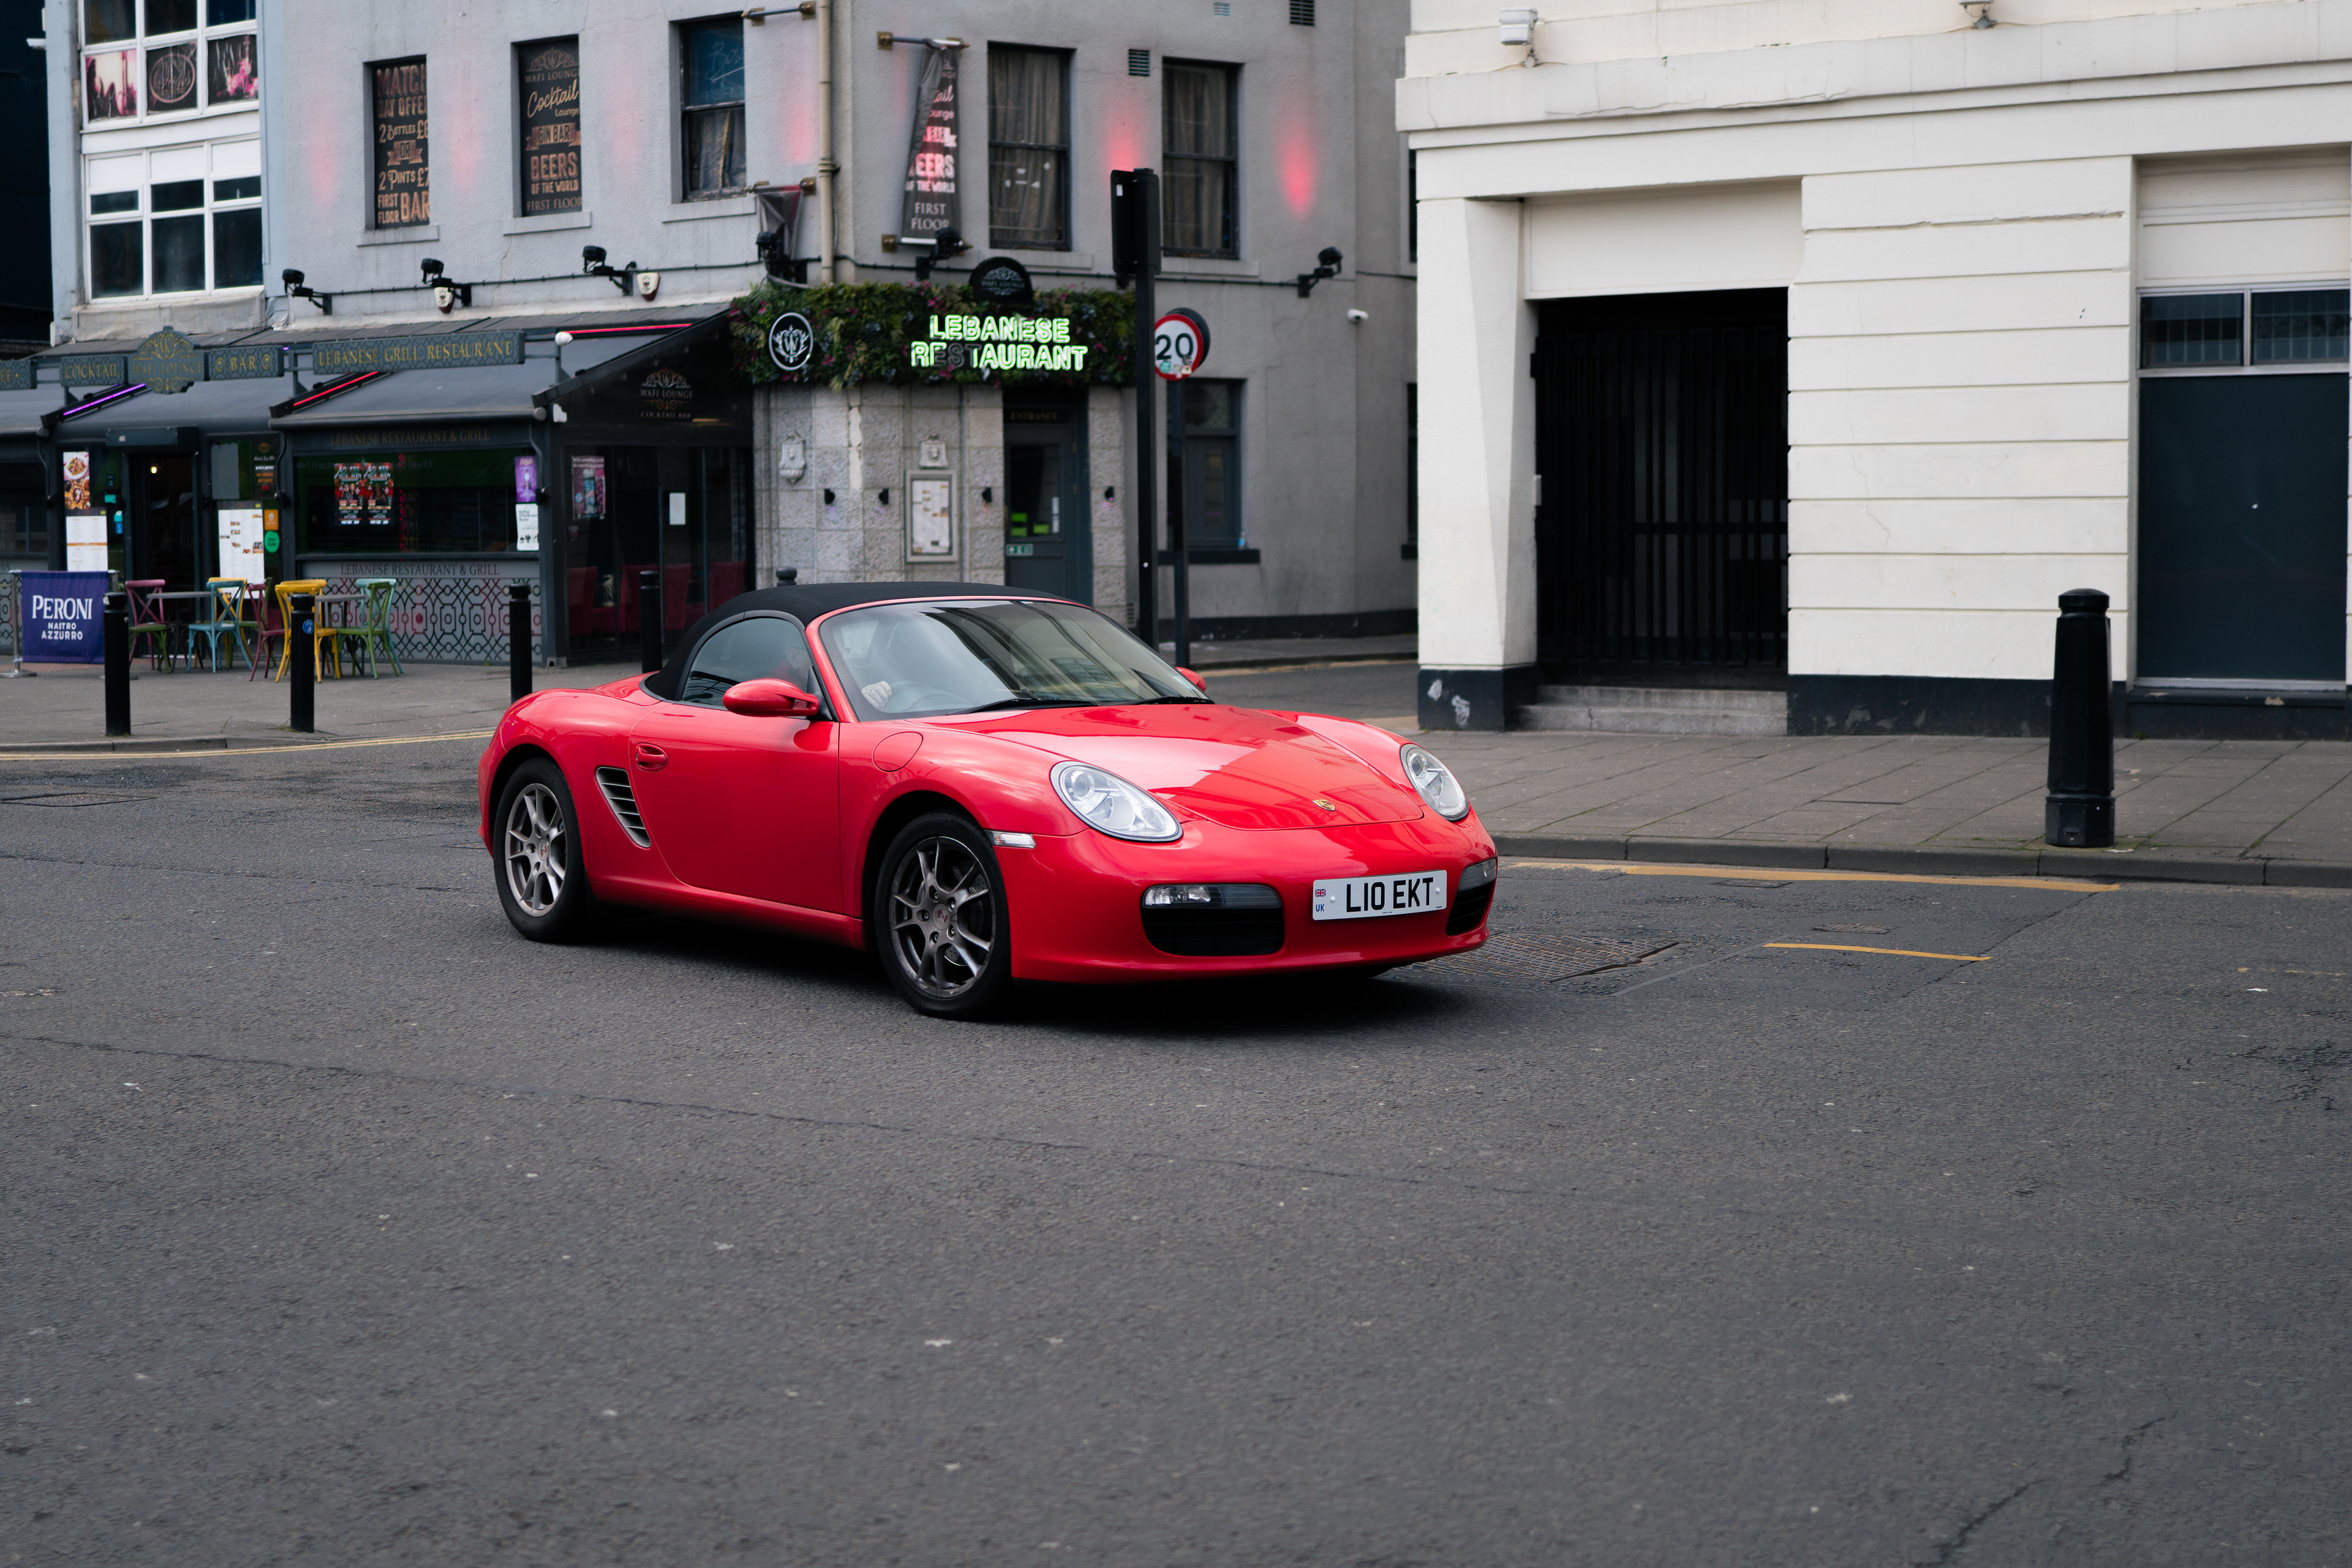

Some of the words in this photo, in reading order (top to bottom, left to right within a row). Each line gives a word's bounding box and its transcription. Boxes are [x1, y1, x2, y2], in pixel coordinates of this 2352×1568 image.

[525, 73, 545, 83] WAFI
[548, 69, 579, 81] LOUNG
[527, 78, 579, 118] Cocktail
[378, 99, 395, 118] DAY
[555, 108, 580, 118] Lounge
[379, 124, 386, 143] 2
[539, 126, 551, 143] GIN
[554, 124, 569, 141] BAR
[401, 142, 410, 159] OR
[531, 152, 578, 181] BEERS
[379, 172, 386, 190] 2
[532, 183, 540, 195] OF
[541, 182, 554, 194] THE
[555, 179, 578, 192] WORLD
[378, 193, 399, 208] FIRST
[401, 190, 429, 222] BAR
[527, 199, 551, 211] FIRST
[554, 197, 582, 209] FLOOR
[914, 202, 947, 216] FIRST
[378, 210, 399, 225] FLOOR
[911, 217, 949, 230] FLOOR
[930, 314, 1071, 343] LEBANESE
[319, 349, 379, 366] LEBANESE
[385, 346, 421, 363] GRILL
[428, 341, 512, 360] RESTAURANT
[1155, 333, 1194, 360] 20
[230, 355, 256, 371] BAR
[911, 341, 1088, 371] RESTAURANT
[65, 363, 120, 379] COCKTAIL
[131, 364, 156, 375] WAFI
[160, 361, 202, 375] LOUNGE
[662, 390, 693, 399] LOUNGE
[1011, 411, 1058, 420] ENTRANCE
[331, 432, 379, 445] LEBANESE
[382, 431, 448, 444] RESTAURANT
[450, 431, 457, 442] &
[460, 429, 491, 442] GRILL
[341, 564, 389, 576] LEBANESE
[392, 564, 458, 576] RESTAURANT
[459, 564, 466, 574] &
[470, 564, 500, 575] GRILL
[32, 595, 93, 620] PERONI
[42, 630, 83, 640] AZZURRO
[1346, 881, 1385, 913] L10
[1393, 877, 1434, 910] EKT
[1316, 903, 1325, 912] UK
